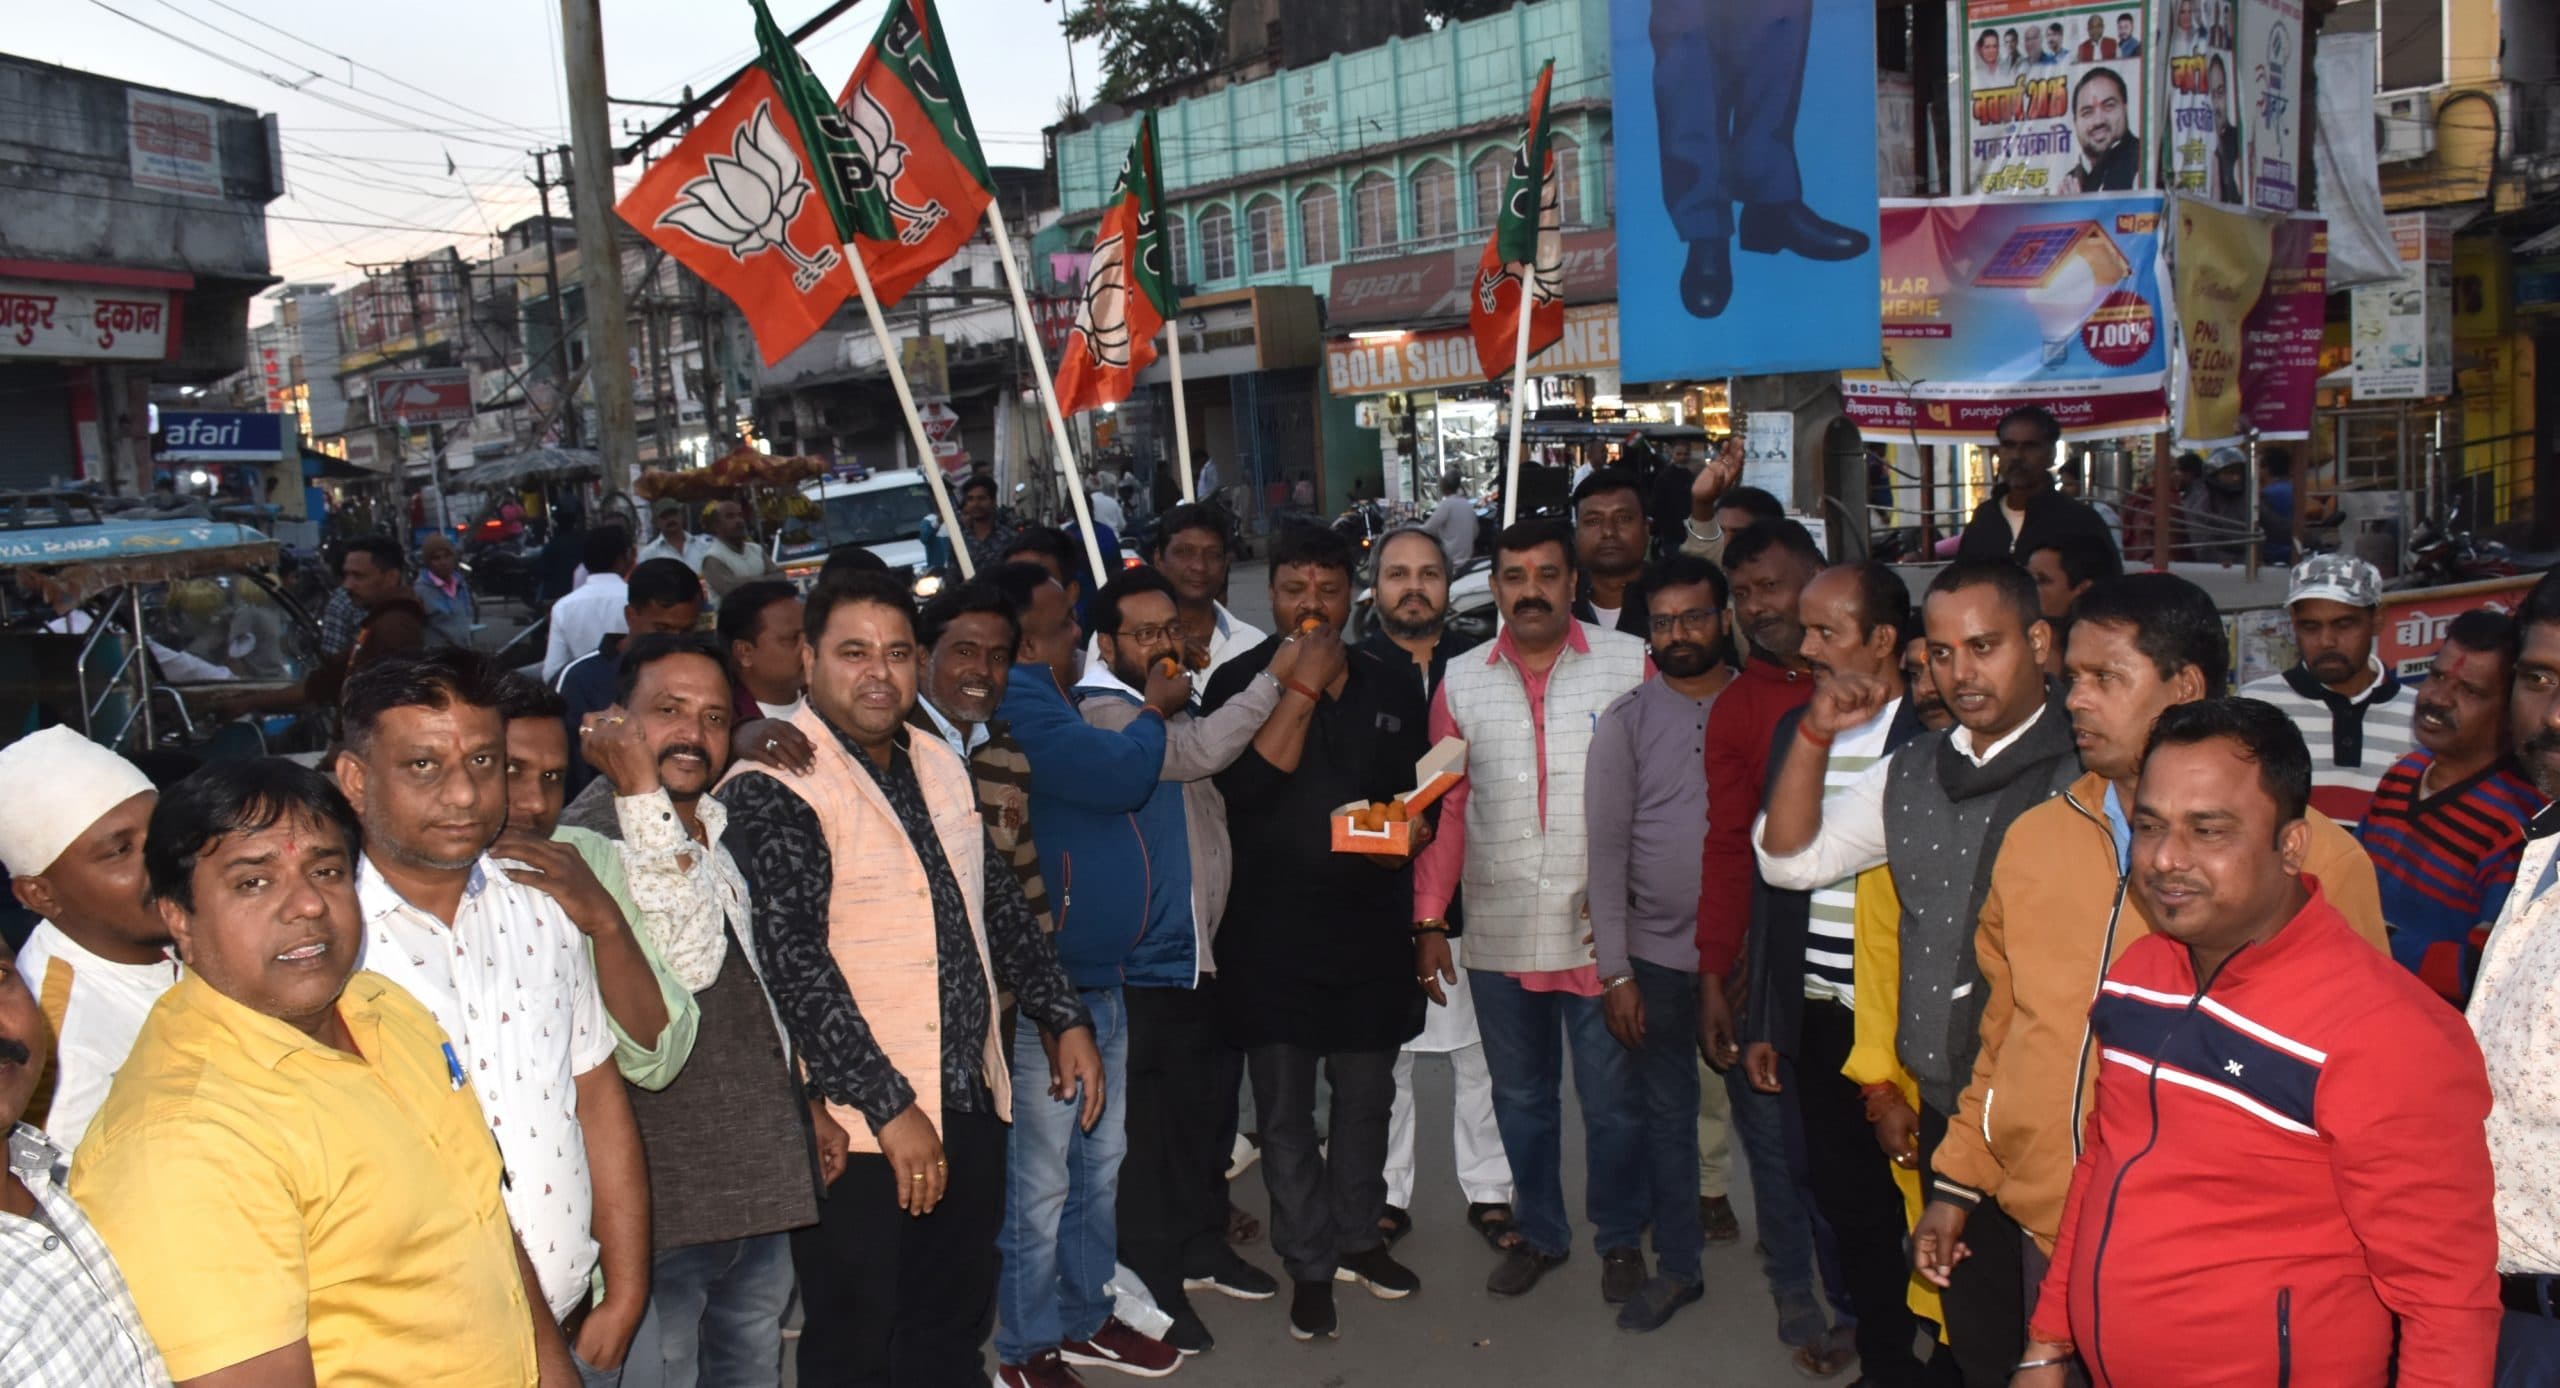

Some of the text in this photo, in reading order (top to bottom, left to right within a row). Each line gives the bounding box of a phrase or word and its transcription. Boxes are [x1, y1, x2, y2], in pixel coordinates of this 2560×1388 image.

[1340, 264, 1434, 305] sparx
[1881, 277, 1929, 294] LAR
[95, 299, 162, 349] दुकान
[2087, 321, 2150, 348] 7.00%
[1330, 345, 1402, 391] BOLA
[1960, 405, 2003, 420] punjab
[2058, 401, 2092, 414] bank
[165, 418, 242, 445] afari
